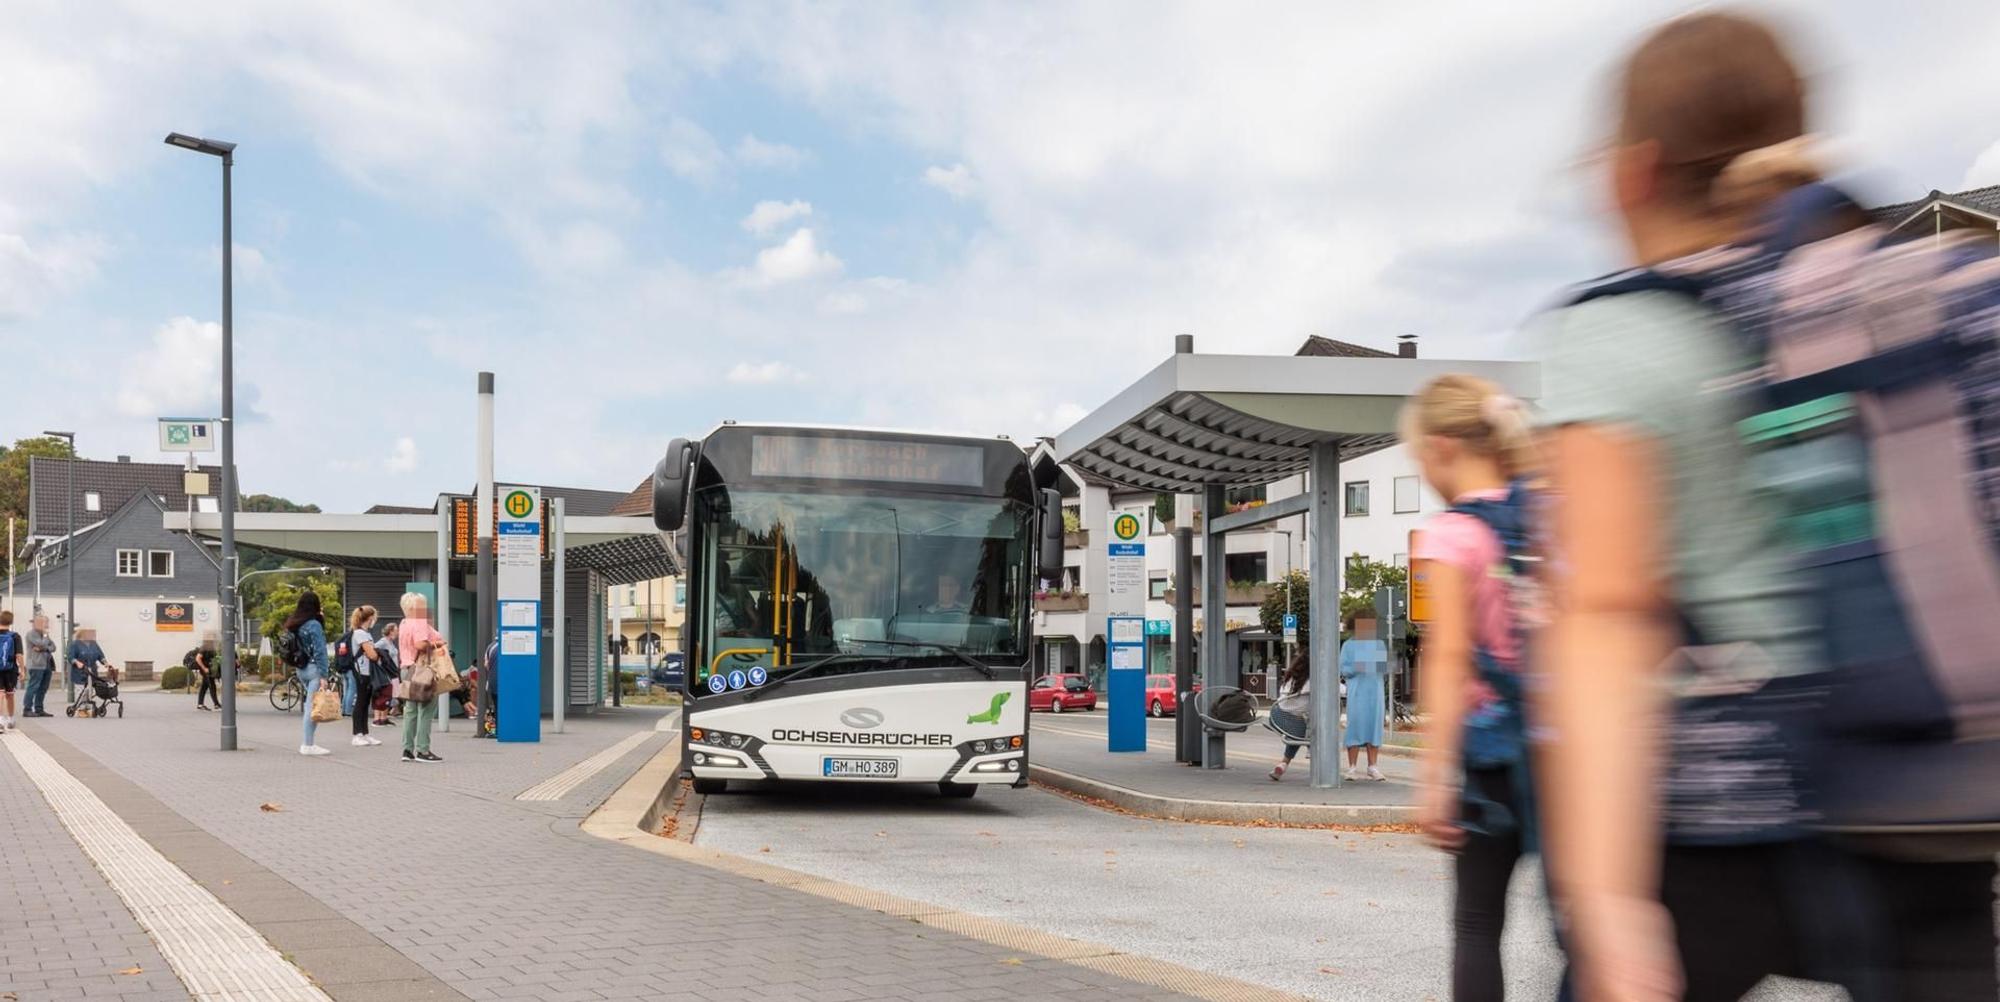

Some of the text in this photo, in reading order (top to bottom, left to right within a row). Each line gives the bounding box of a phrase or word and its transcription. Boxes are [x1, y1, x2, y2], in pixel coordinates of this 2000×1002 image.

[513, 496, 526, 513] H
[1121, 519, 1133, 535] H
[1285, 616, 1294, 627] P
[771, 728, 953, 747] OCHSENBRÜCHER
[832, 760, 896, 774] GM HO 389
